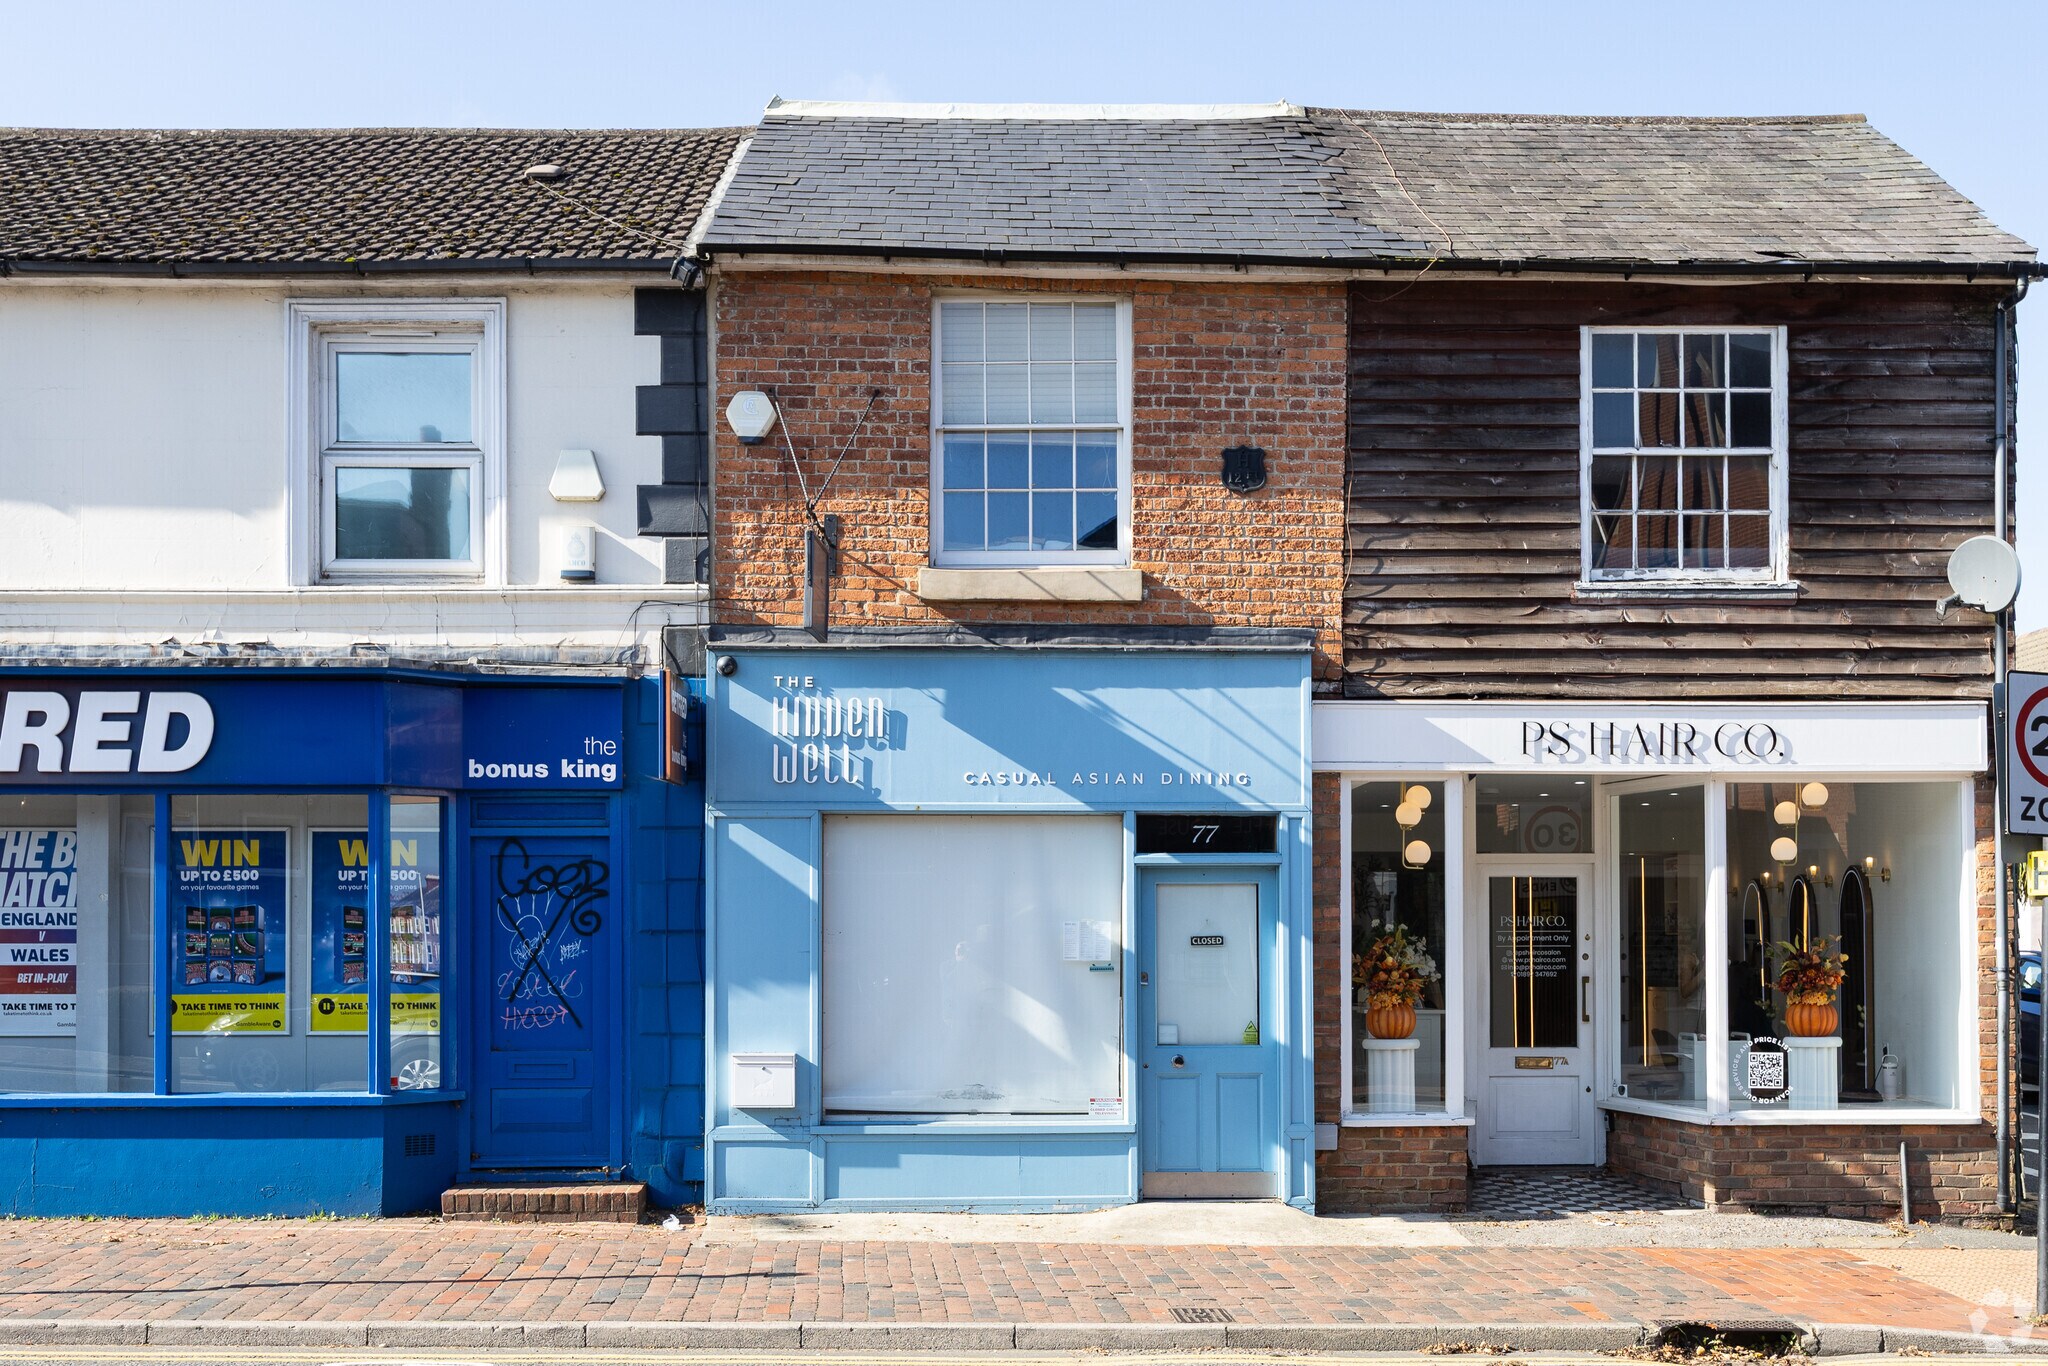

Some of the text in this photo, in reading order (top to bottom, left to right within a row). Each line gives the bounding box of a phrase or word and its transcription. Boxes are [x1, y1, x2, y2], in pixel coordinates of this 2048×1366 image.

[774, 676, 814, 687] THE
[0, 691, 214, 772] RED
[584, 736, 616, 755] the
[1522, 721, 1784, 757] PS HAIR CO.
[468, 759, 616, 782] bonus king
[963, 772, 1252, 785] CASUAL ASIAN DINING
[1192, 825, 1219, 844] 77
[51, 831, 77, 868] B
[181, 840, 260, 867] WIN
[338, 840, 417, 867] WN
[181, 870, 259, 881] UP TO £500
[338, 870, 417, 881] UP T 500
[2, 913, 77, 926] ENGLAND
[1546, 916, 1567, 927] CO.
[1192, 937, 1222, 945] CLOSED
[1497, 935, 1506, 943] By
[1553, 935, 1569, 943] Only
[11, 949, 69, 962] WALES
[17, 973, 68, 983] BET IN-PLAY
[249, 1002, 279, 1010] THINK
[338, 1002, 363, 1010] TAKE
[391, 1002, 436, 1010] TO THINK
[1754, 1036, 1777, 1044] PRICE
[1777, 1040, 1793, 1053] LIST
[1740, 1040, 1753, 1054] AND
[1733, 1053, 1743, 1090] SERVICES
[1742, 1090, 1757, 1102] OUR
[1775, 1085, 1794, 1102] SCAN
